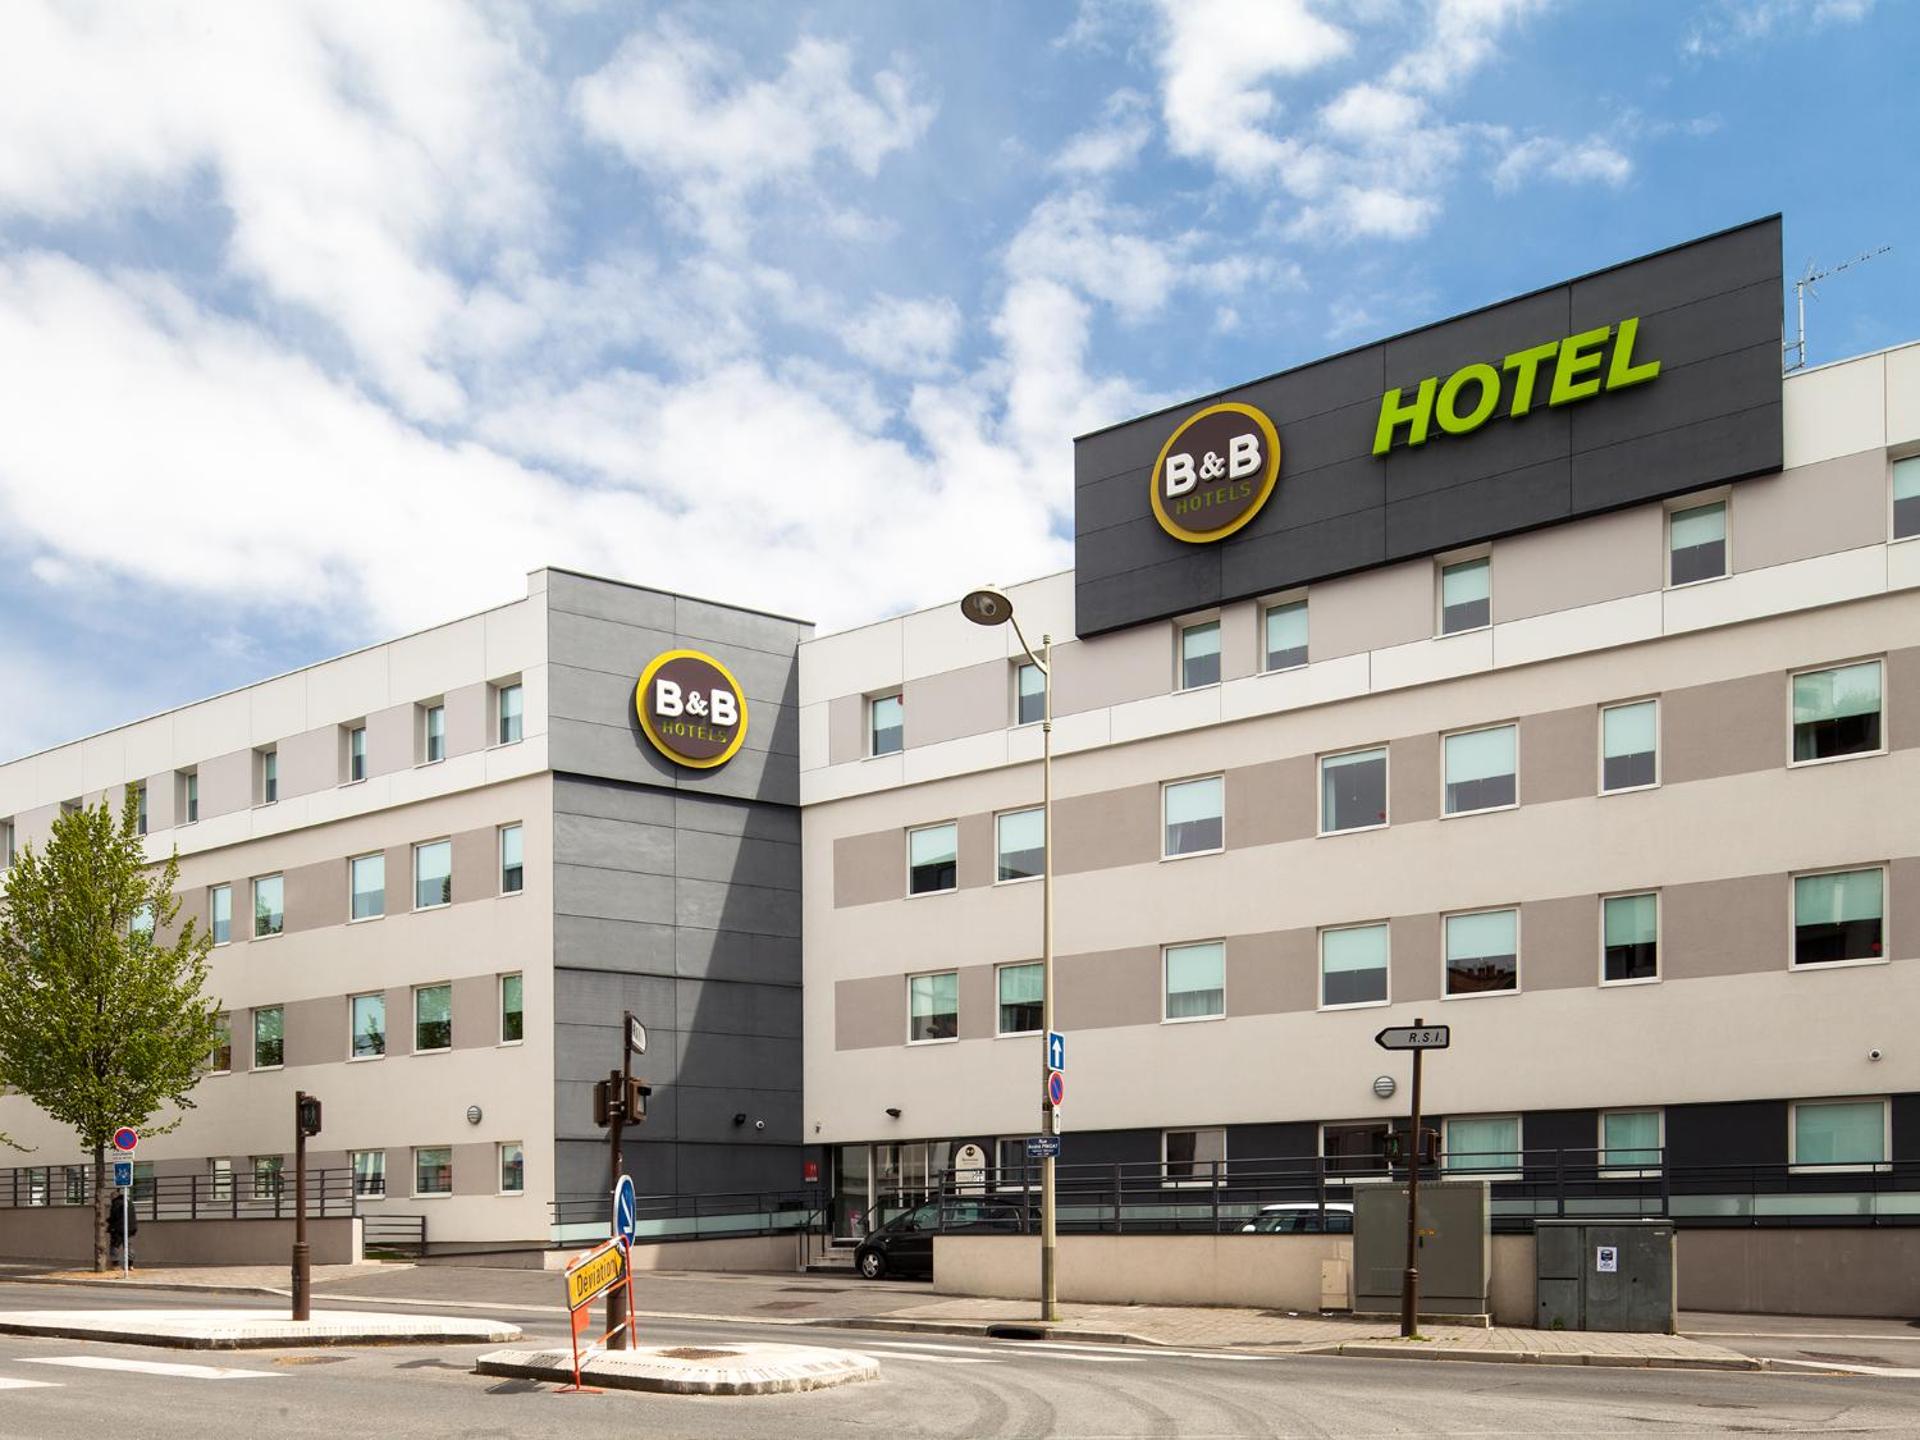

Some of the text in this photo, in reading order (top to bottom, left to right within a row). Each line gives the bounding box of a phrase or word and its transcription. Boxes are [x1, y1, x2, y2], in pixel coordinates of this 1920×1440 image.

[1372, 317, 1661, 456] HOTEL
[1166, 433, 1262, 499] B&B
[1175, 481, 1252, 515] HOTELS
[656, 679, 738, 727] B&B
[662, 721, 728, 744] HOTELS
[1408, 1031, 1443, 1043] R.S.I.
[576, 1256, 619, 1297] Déviation
